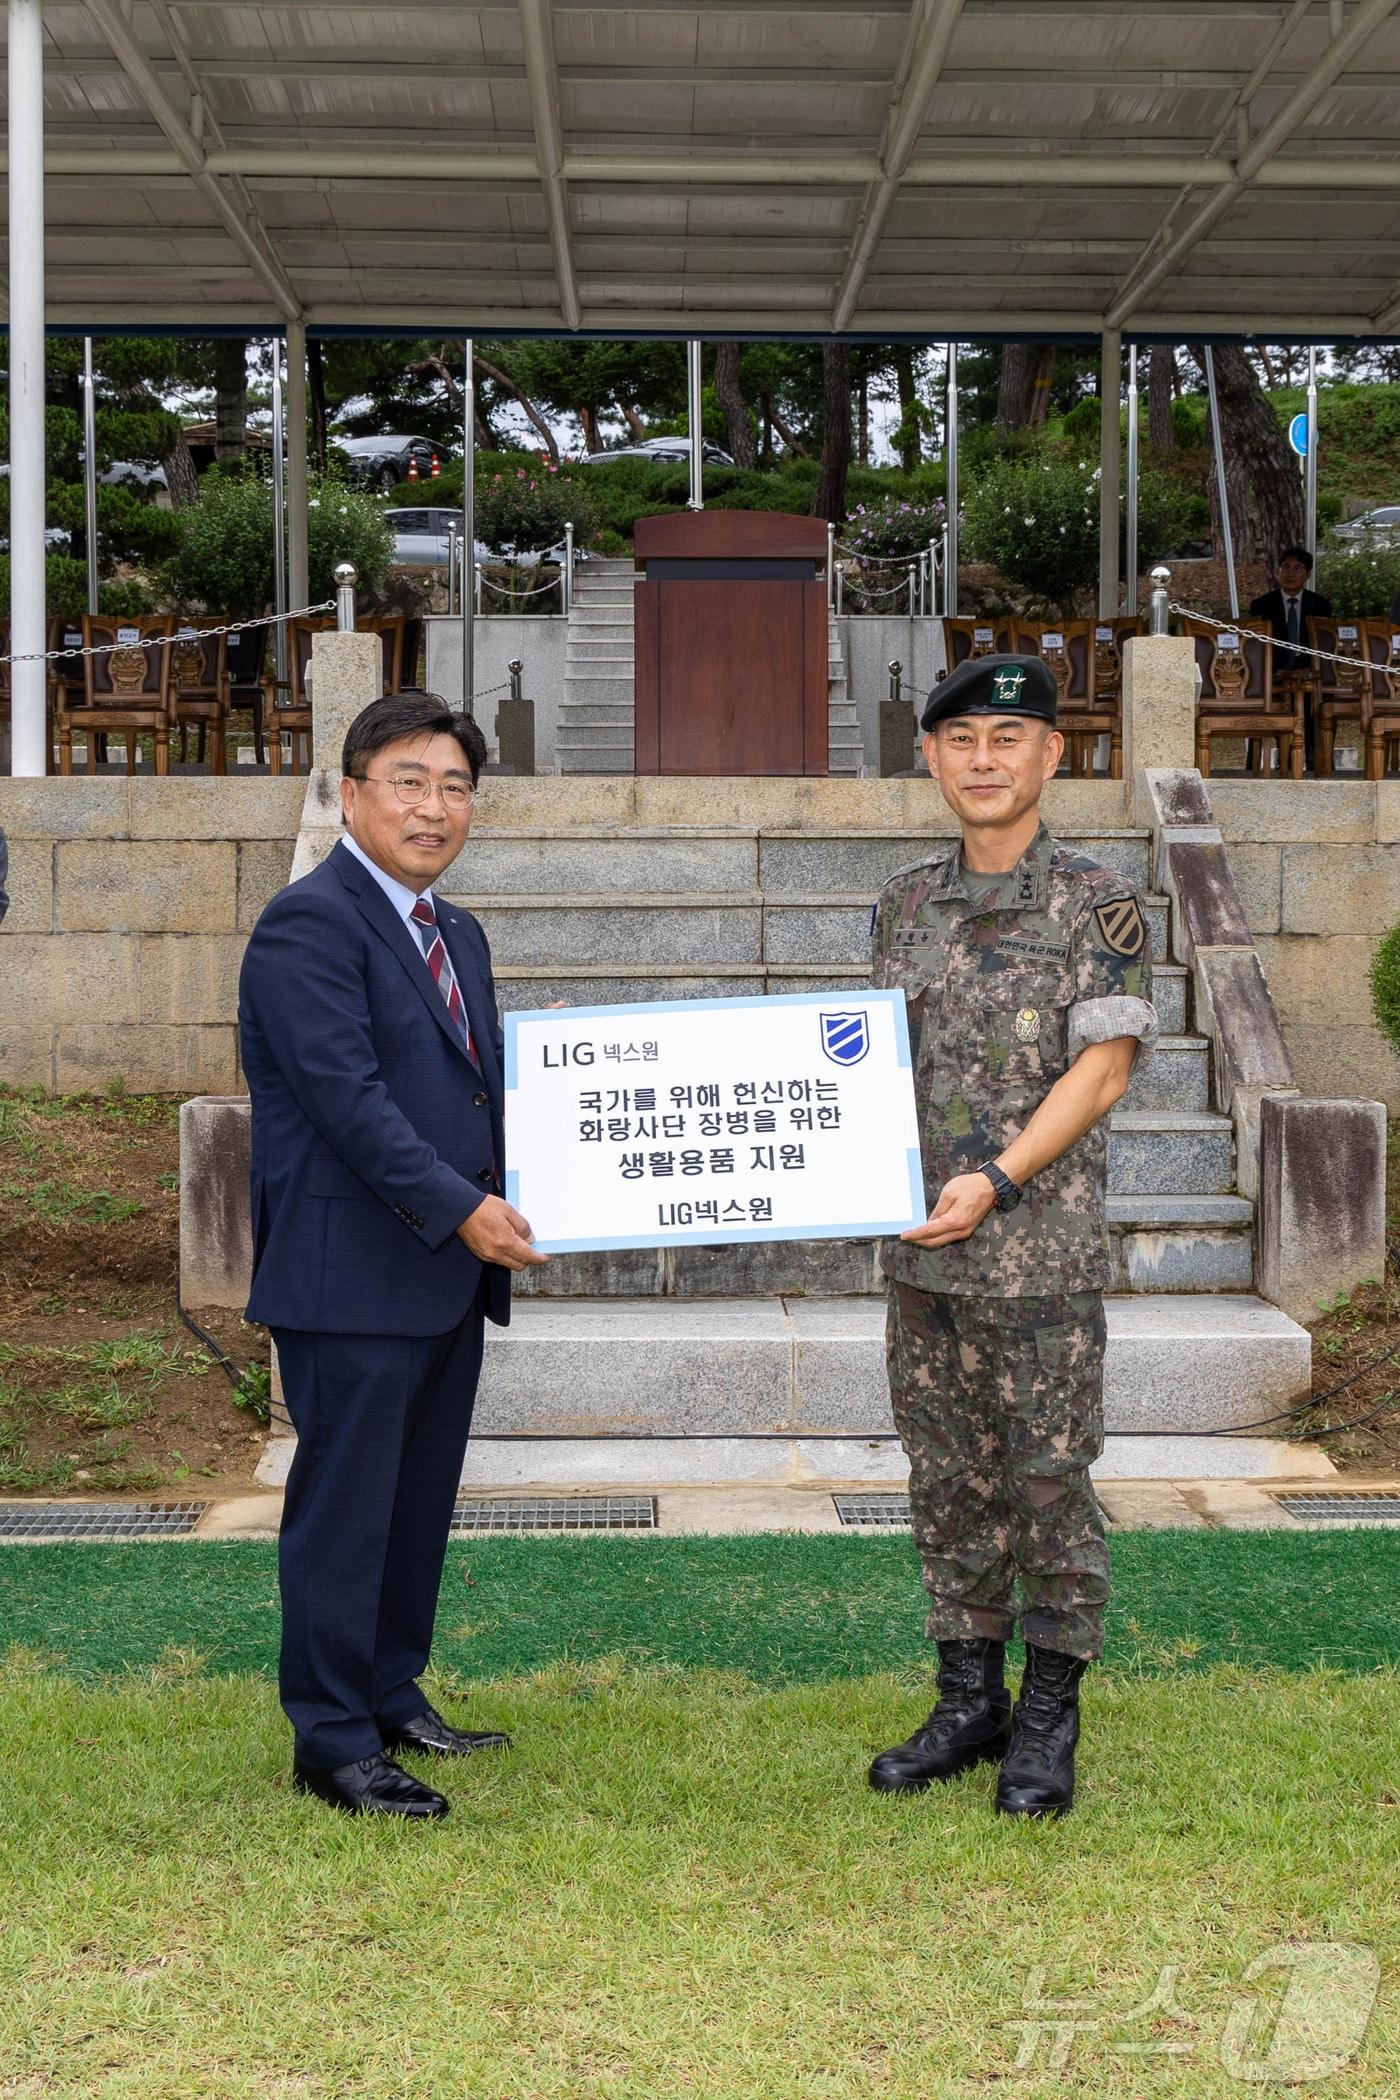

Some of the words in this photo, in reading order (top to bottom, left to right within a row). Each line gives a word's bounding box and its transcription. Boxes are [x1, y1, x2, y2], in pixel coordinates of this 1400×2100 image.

[997, 939, 1028, 953] 대한민국
[1028, 945, 1045, 956] 육군
[1046, 947, 1067, 959] ROKA
[543, 1041, 595, 1068] LIG
[603, 1040, 659, 1063] 넥스원
[578, 1087, 657, 1114] 국가를
[669, 1083, 721, 1109] 위해
[733, 1078, 839, 1106] 헌신하는
[578, 1114, 687, 1143] 화랑사단
[698, 1109, 777, 1137] 장병을
[789, 1105, 842, 1131] 위한
[618, 1147, 735, 1180] 생활용품
[749, 1143, 806, 1171] 지원
[658, 1197, 773, 1226] LIG넥스원
